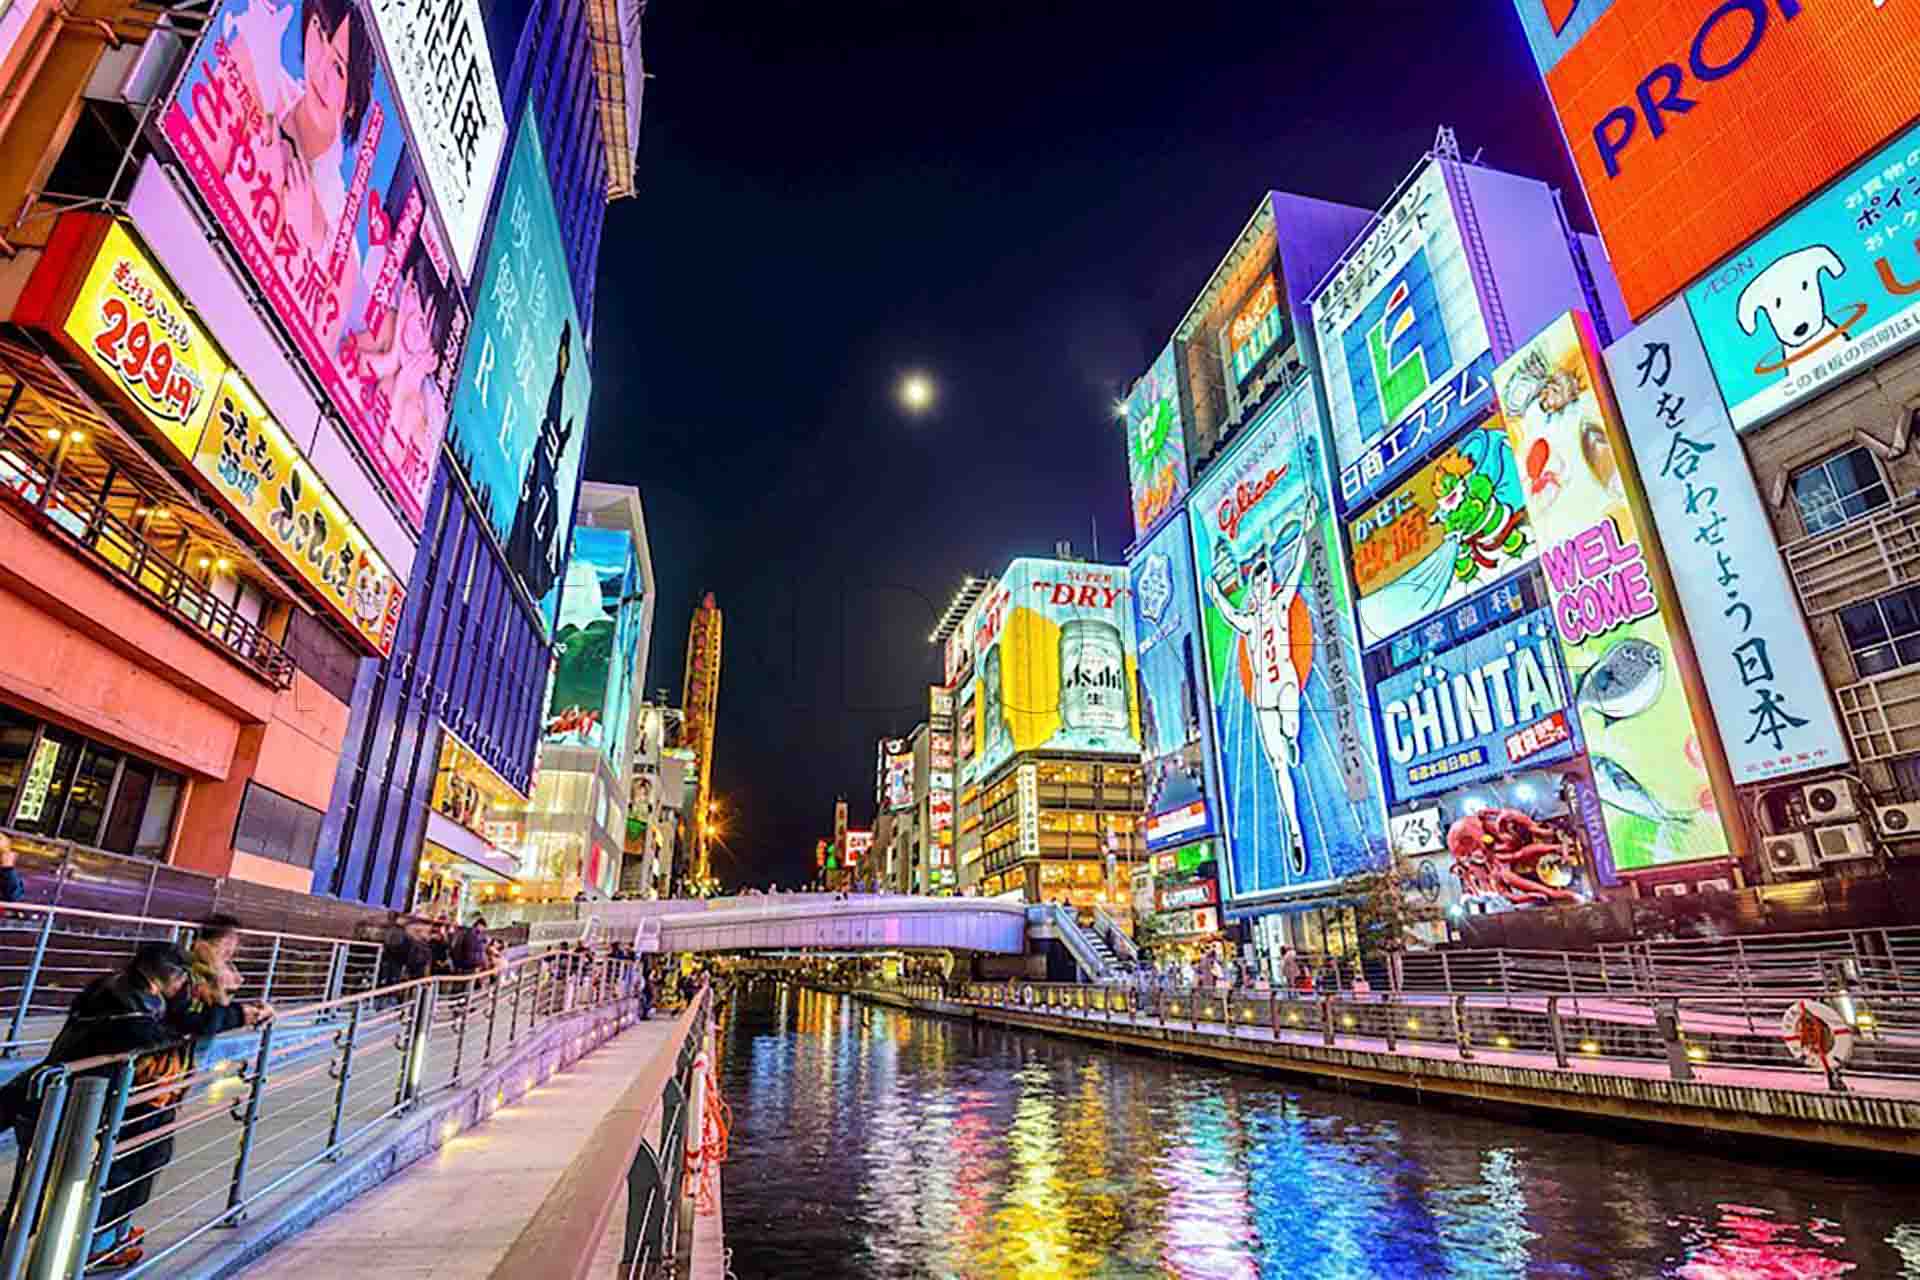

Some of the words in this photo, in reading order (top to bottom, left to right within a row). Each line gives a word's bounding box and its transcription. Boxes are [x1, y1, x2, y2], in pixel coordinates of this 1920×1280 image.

[1593, 0, 1803, 178] PRO
[1340, 370, 1490, 501] 日商エステム
[1216, 464, 1289, 541] Glico
[1636, 341, 1811, 752] 力を合わせよう日本
[1556, 560, 1656, 643] COME
[1065, 664, 1124, 690] Asahi
